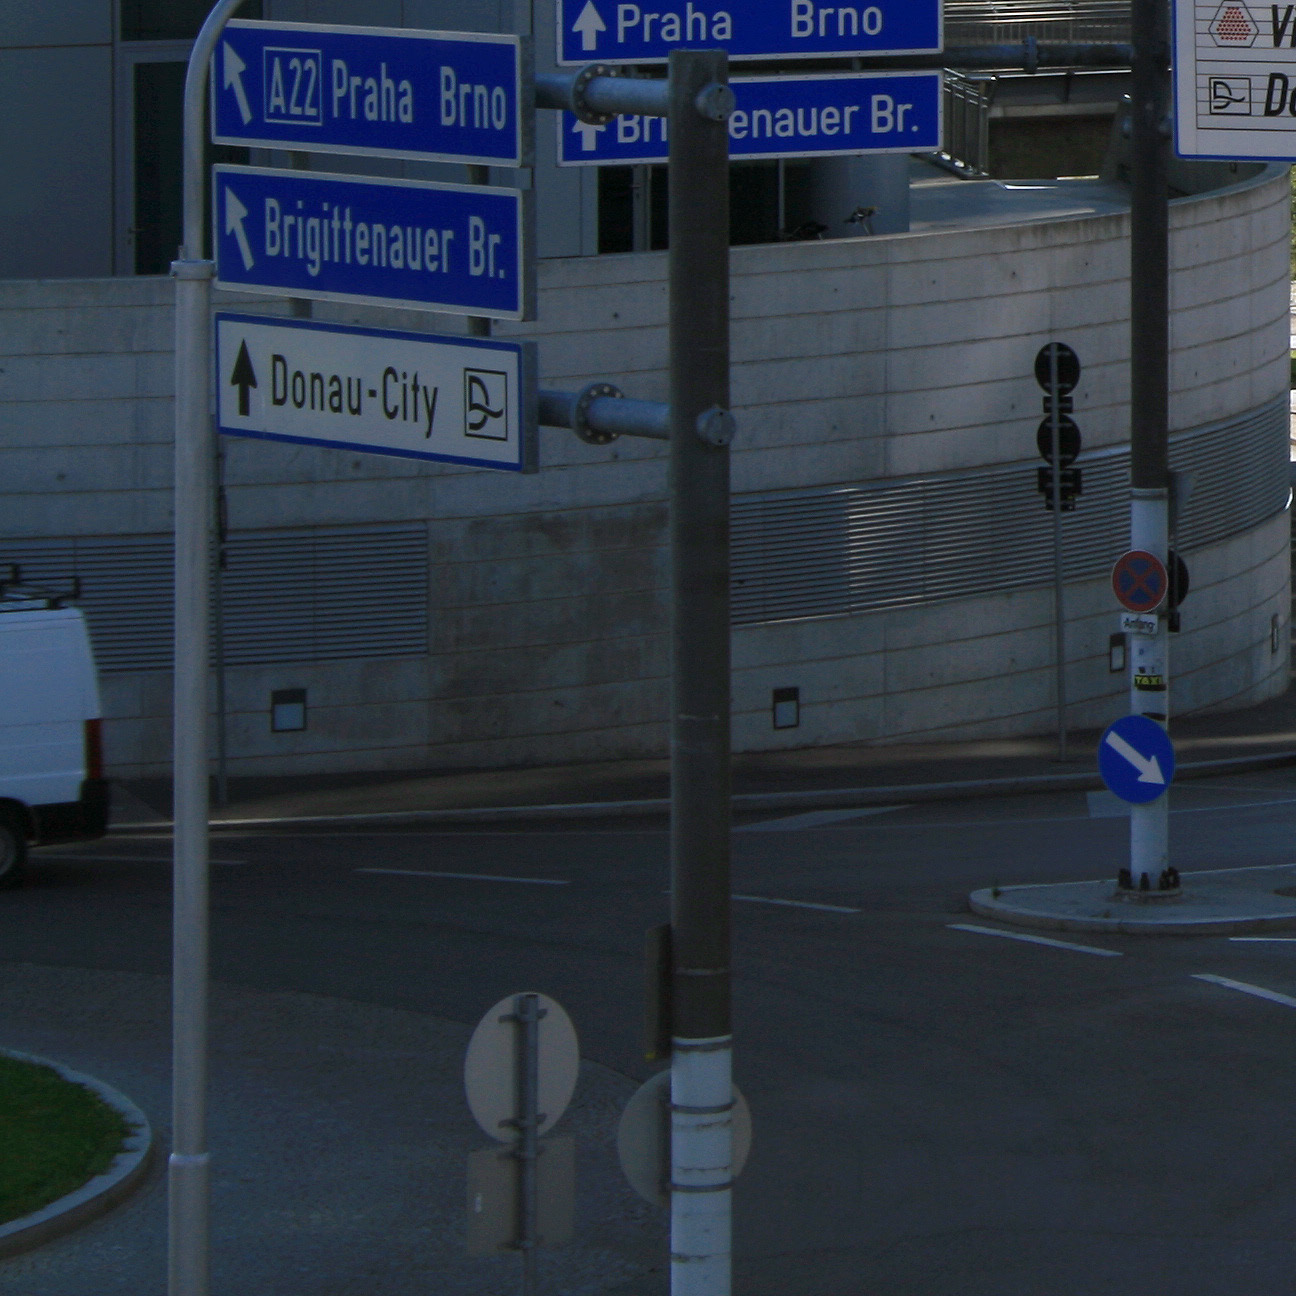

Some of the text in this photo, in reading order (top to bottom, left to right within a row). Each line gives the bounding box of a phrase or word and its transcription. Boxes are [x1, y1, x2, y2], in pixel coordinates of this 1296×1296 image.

[617, 2, 733, 44] Praha
[268, 55, 507, 131] A22 Praha Brno
[617, 93, 919, 145] Brienauer Br.
[264, 197, 505, 280] Brigittenauer Br.
[271, 353, 440, 440] Donau-City
